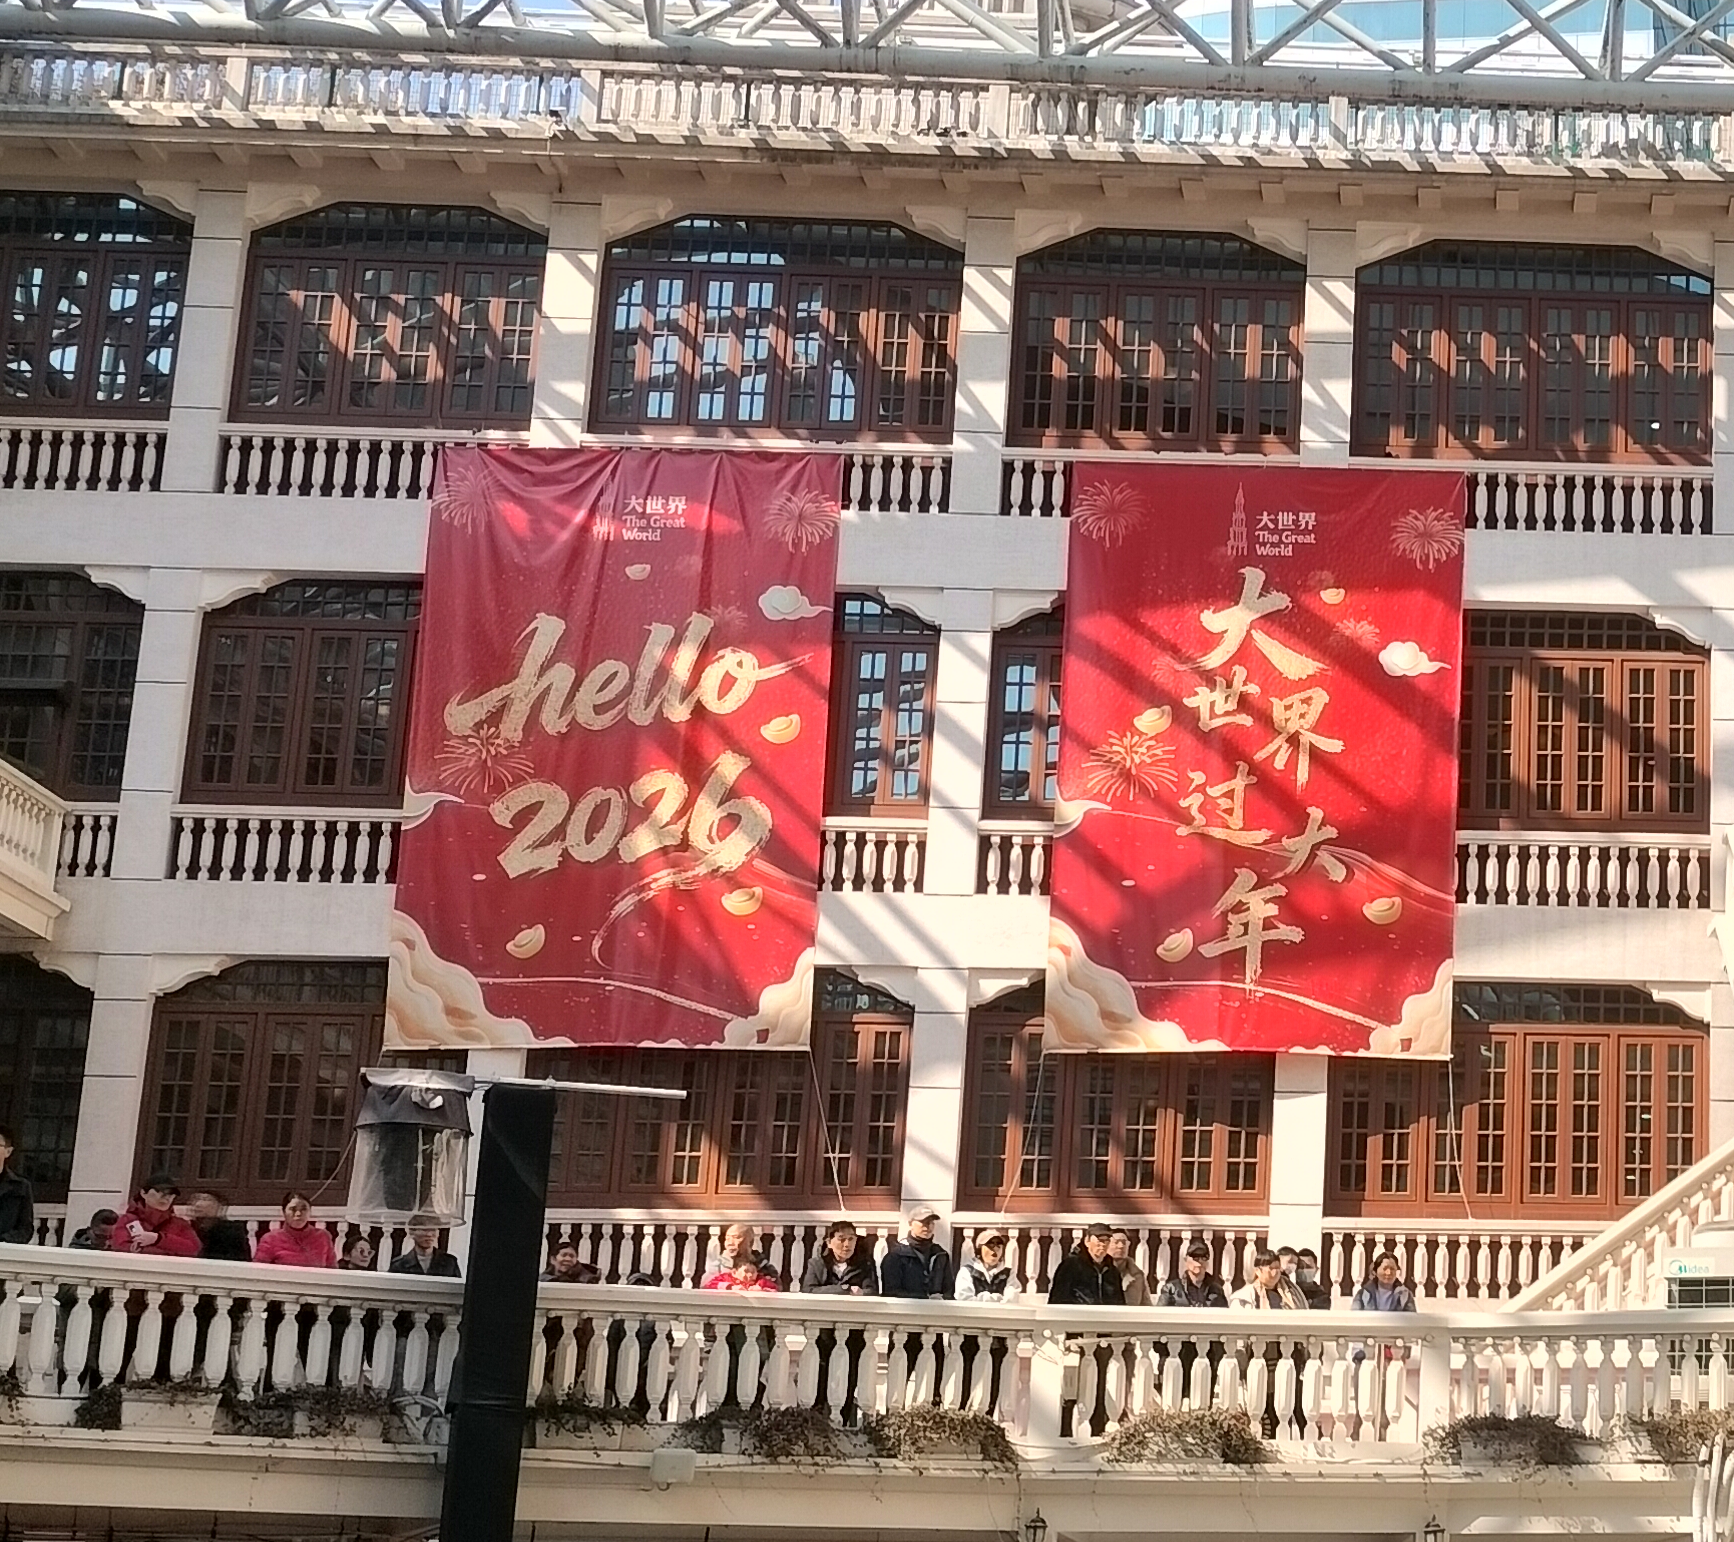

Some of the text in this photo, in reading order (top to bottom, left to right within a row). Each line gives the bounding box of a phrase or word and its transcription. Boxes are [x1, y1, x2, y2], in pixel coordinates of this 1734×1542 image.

[623, 494, 688, 515] 大世界
[621, 515, 687, 529] The Great
[1255, 510, 1317, 530] 大世界
[621, 527, 662, 542] World
[1254, 530, 1317, 545] The Great
[1255, 543, 1294, 557] World
[443, 611, 814, 744] hello
[488, 749, 773, 969] 2026
